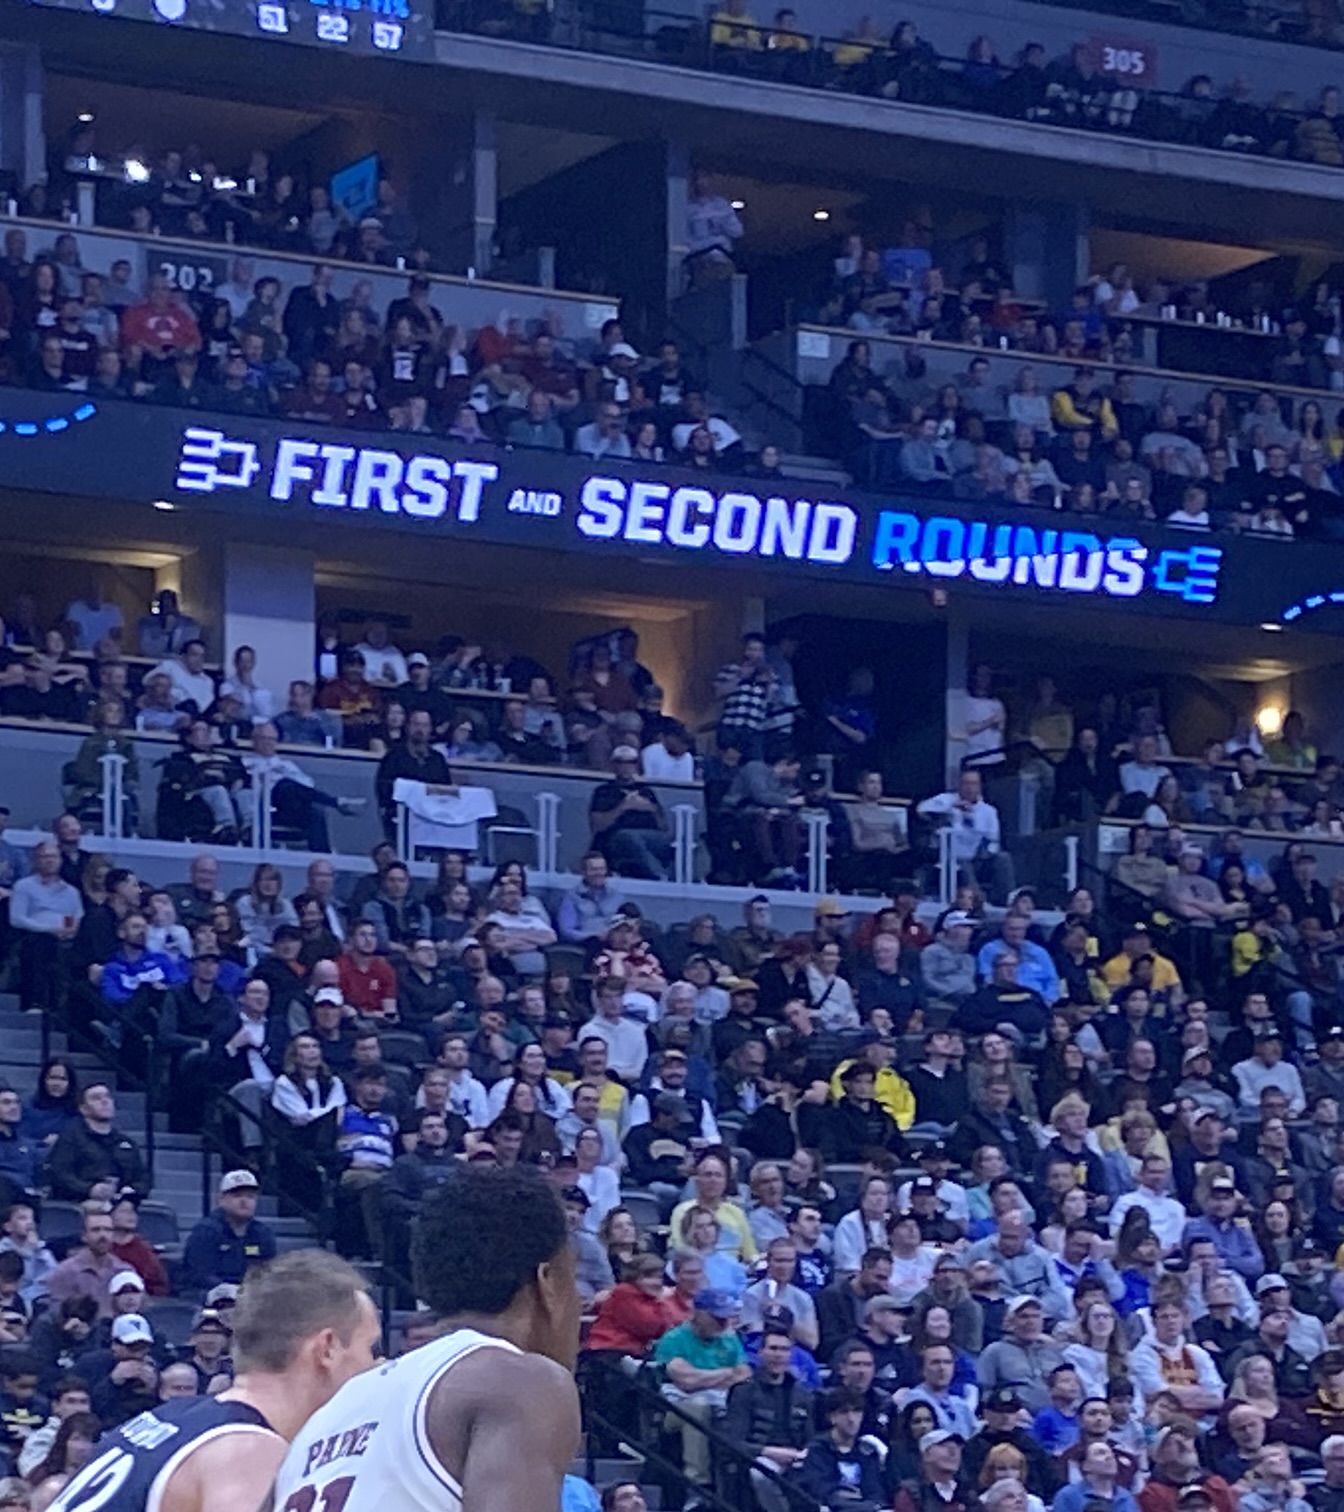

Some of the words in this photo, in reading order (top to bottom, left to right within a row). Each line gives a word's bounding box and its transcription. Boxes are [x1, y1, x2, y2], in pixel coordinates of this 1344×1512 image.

[1103, 47, 1145, 74] 305
[160, 262, 213, 293] 202
[270, 438, 498, 522] FIRST
[508, 489, 561, 516] AND
[577, 475, 857, 566] SECOND
[872, 509, 1149, 598] ROUNDS
[302, 1421, 380, 1478] PAYNE
